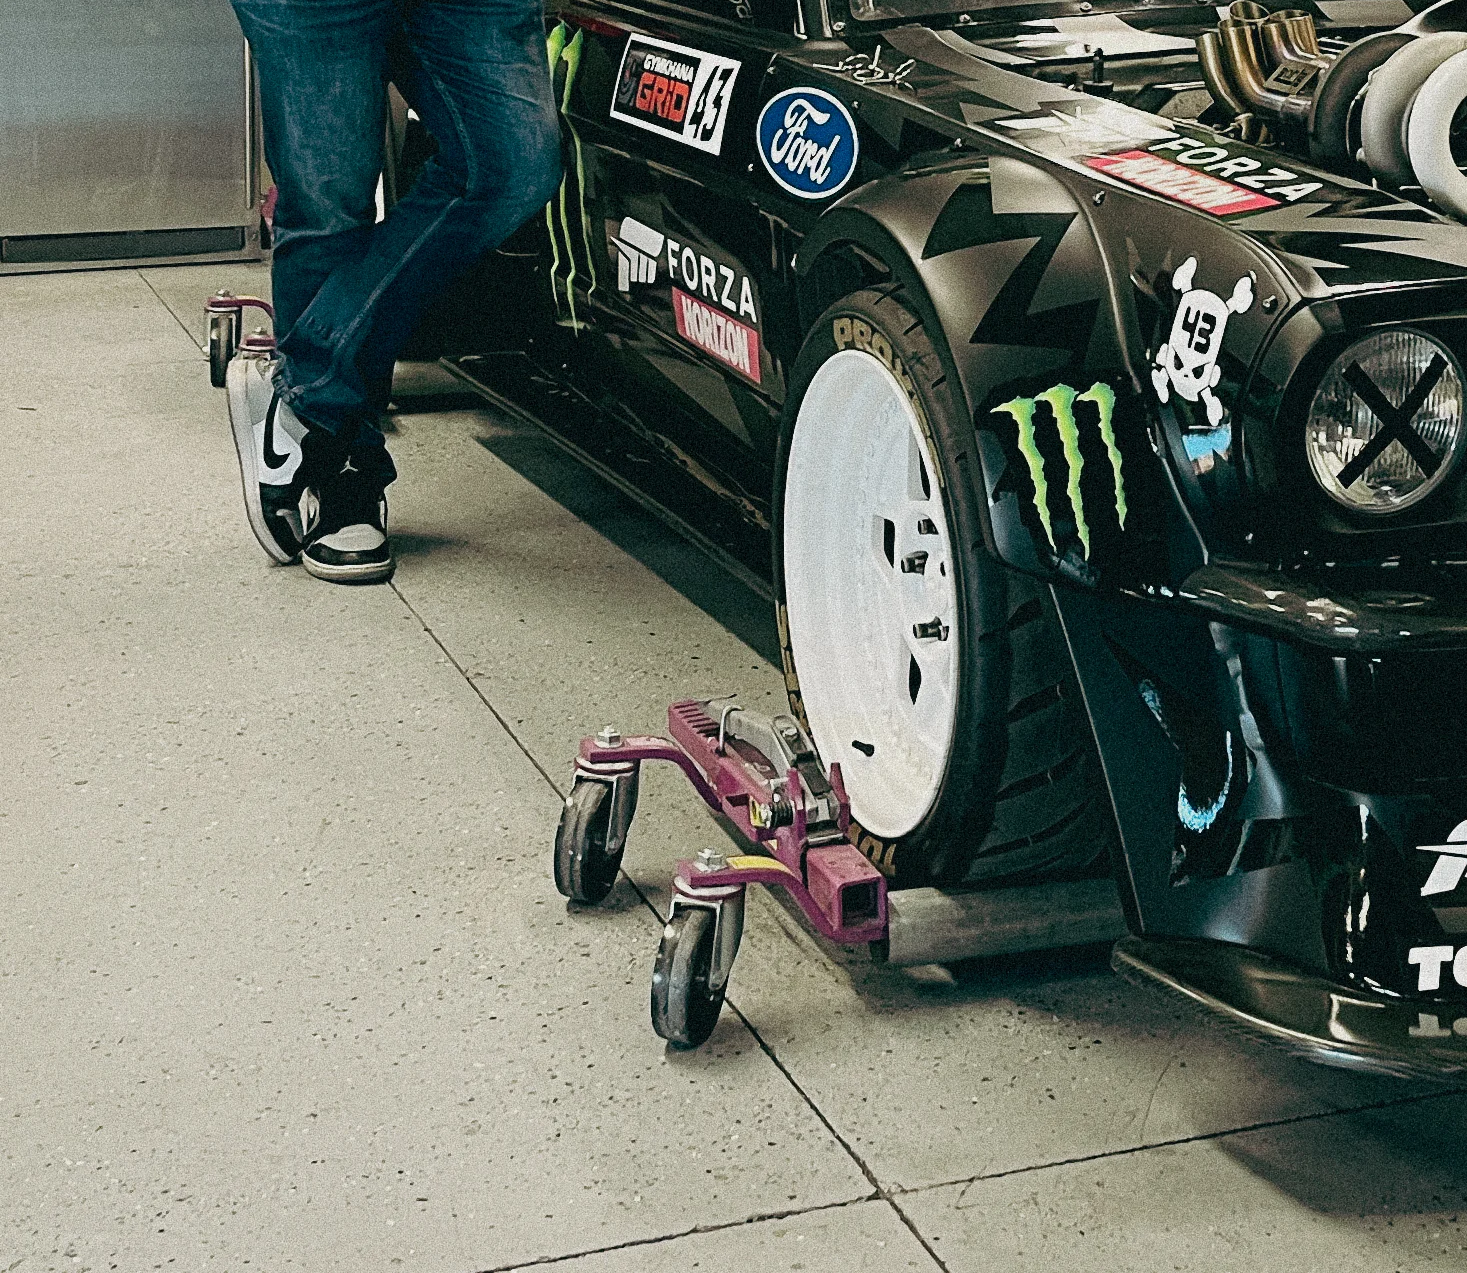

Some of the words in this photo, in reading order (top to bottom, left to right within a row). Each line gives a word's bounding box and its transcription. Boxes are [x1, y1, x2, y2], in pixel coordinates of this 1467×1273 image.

[771, 99, 842, 185] Ford
[1148, 137, 1324, 201] FORZA
[667, 239, 758, 324] FORZA
[681, 293, 751, 375] HORIZON
[1182, 306, 1217, 355] 43
